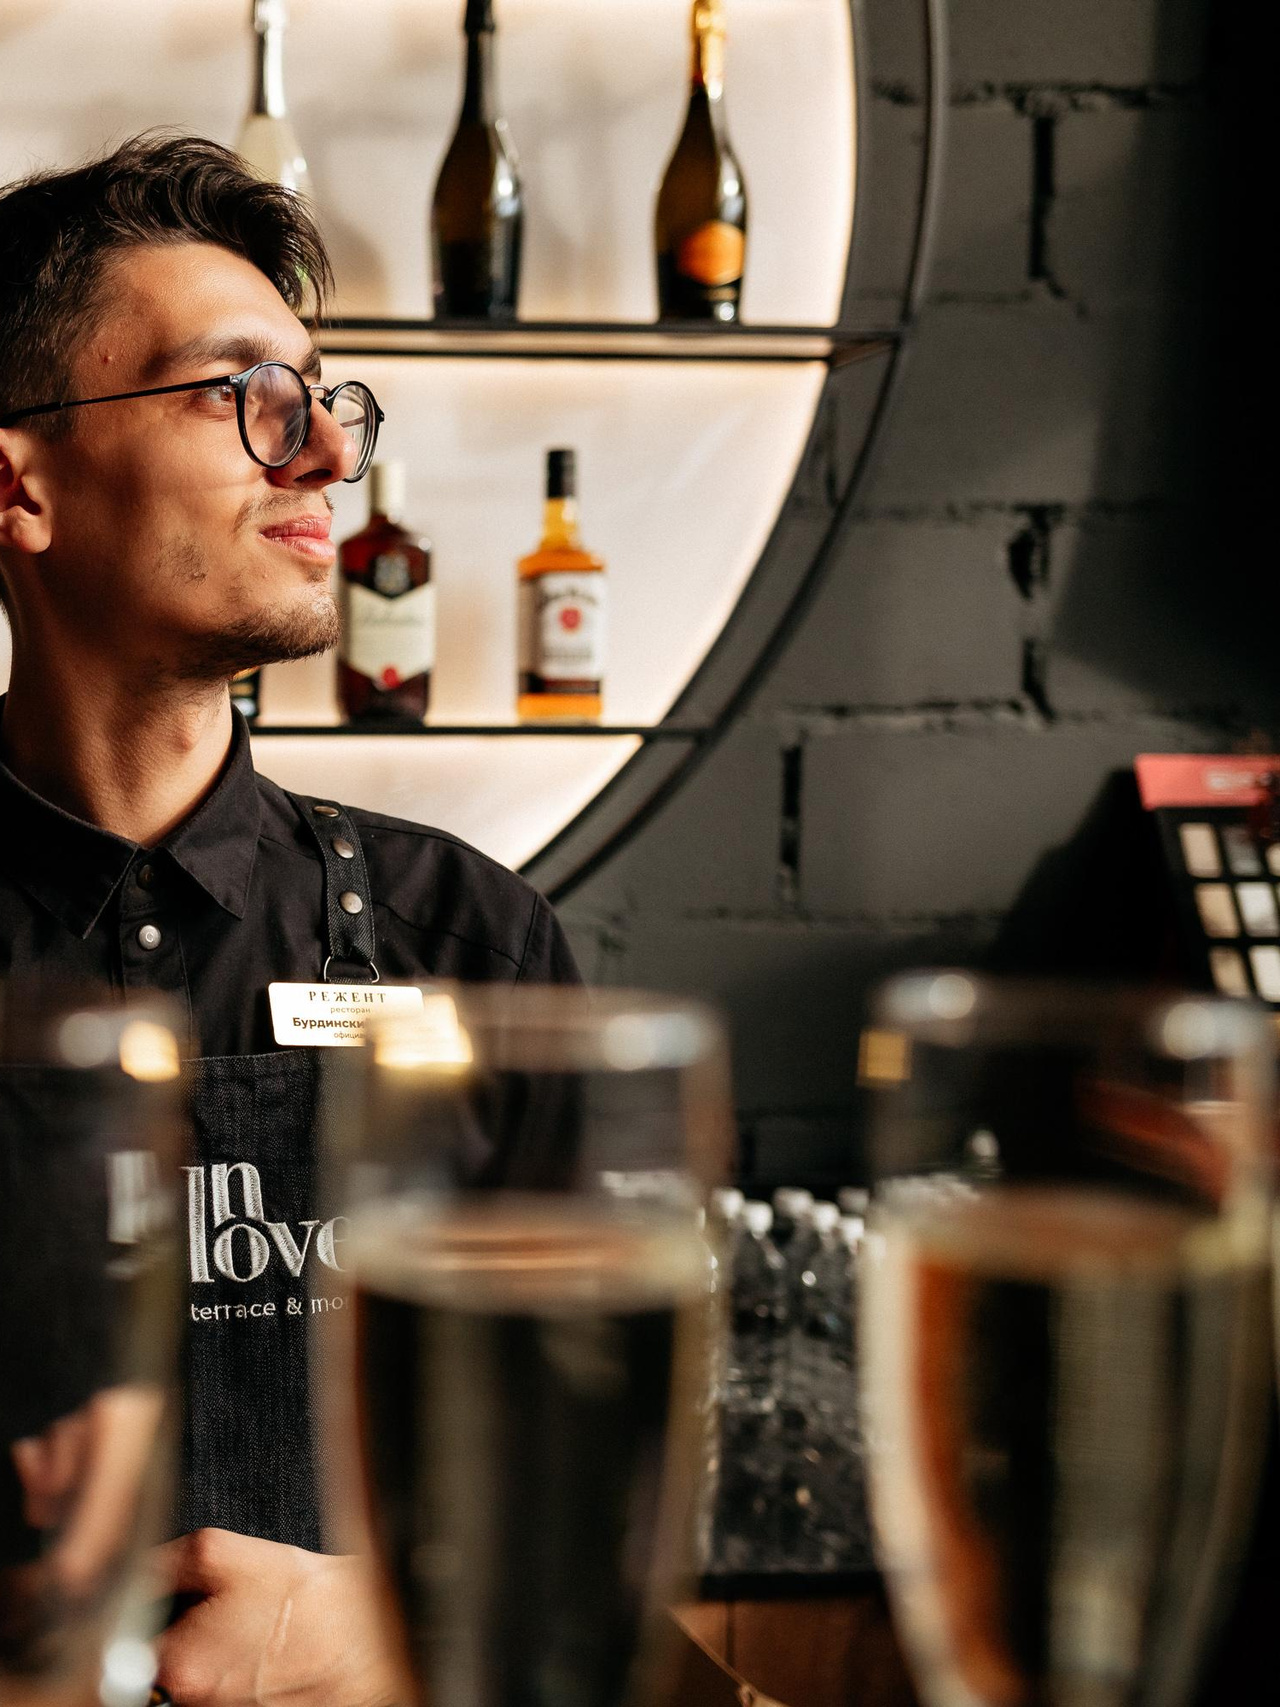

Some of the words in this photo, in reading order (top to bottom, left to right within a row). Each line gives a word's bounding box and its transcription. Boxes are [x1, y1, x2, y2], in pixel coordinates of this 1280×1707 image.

[308, 991, 387, 1004] РЕЖЕНТ
[330, 1006, 371, 1014] ресторан
[292, 1016, 366, 1030] Бурдински
[191, 1302, 276, 1321] terrace
[287, 1297, 303, 1316] &
